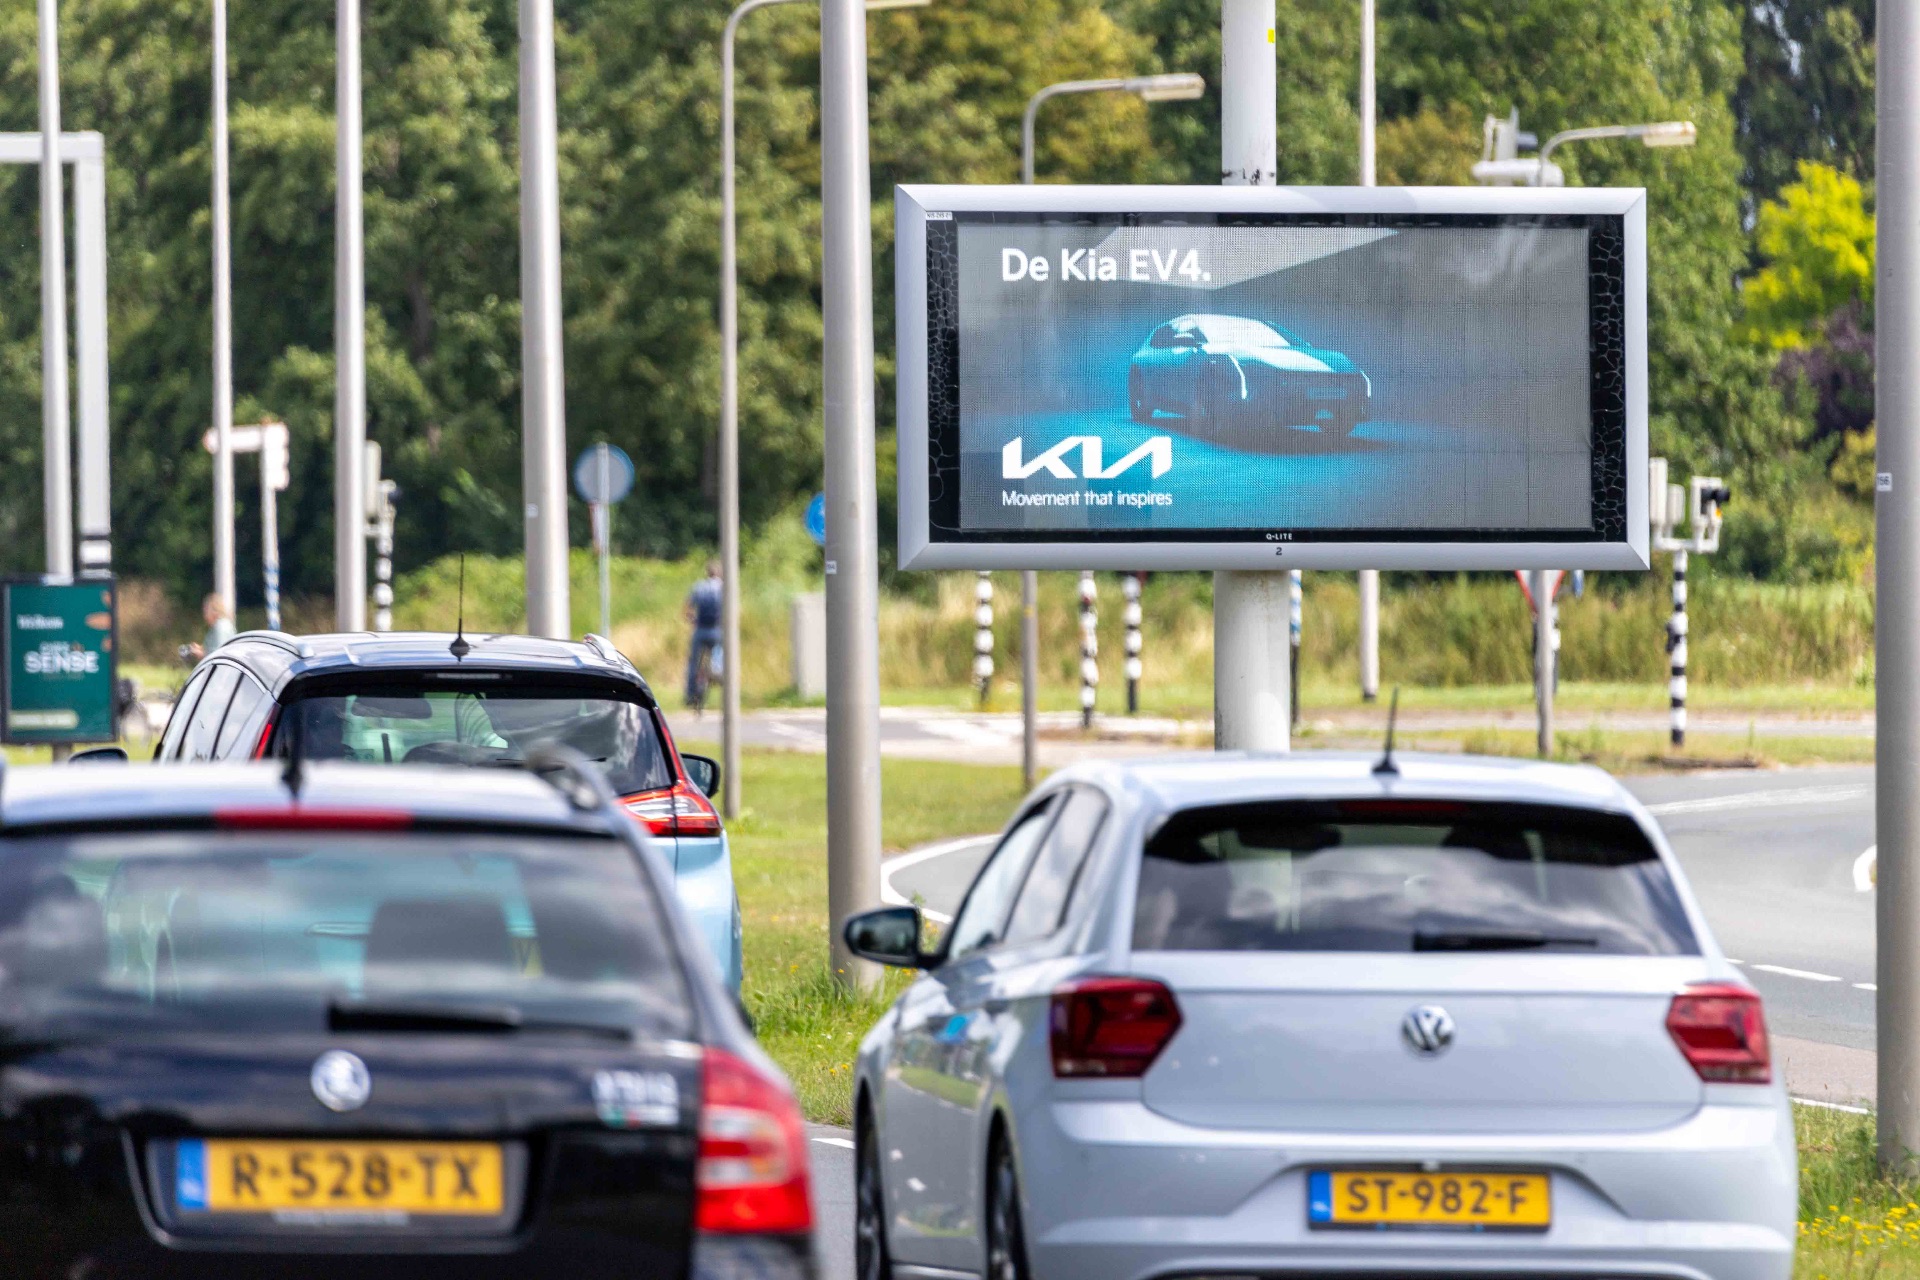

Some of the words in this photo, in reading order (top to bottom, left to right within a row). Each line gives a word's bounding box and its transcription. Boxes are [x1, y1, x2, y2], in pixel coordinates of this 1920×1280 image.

[1001, 248, 1050, 281] De
[1061, 248, 1118, 281] Kia
[1130, 248, 1211, 282] EV4.
[1002, 436, 1173, 479] KIA
[1002, 490, 1080, 506] Movement
[1084, 490, 1114, 506] that
[1117, 490, 1173, 509] inspires
[1275, 546, 1283, 556] 2
[24, 650, 99, 673] SENSE
[230, 1152, 481, 1199] R-528-TX
[1346, 1178, 1530, 1215] ST-982-F
